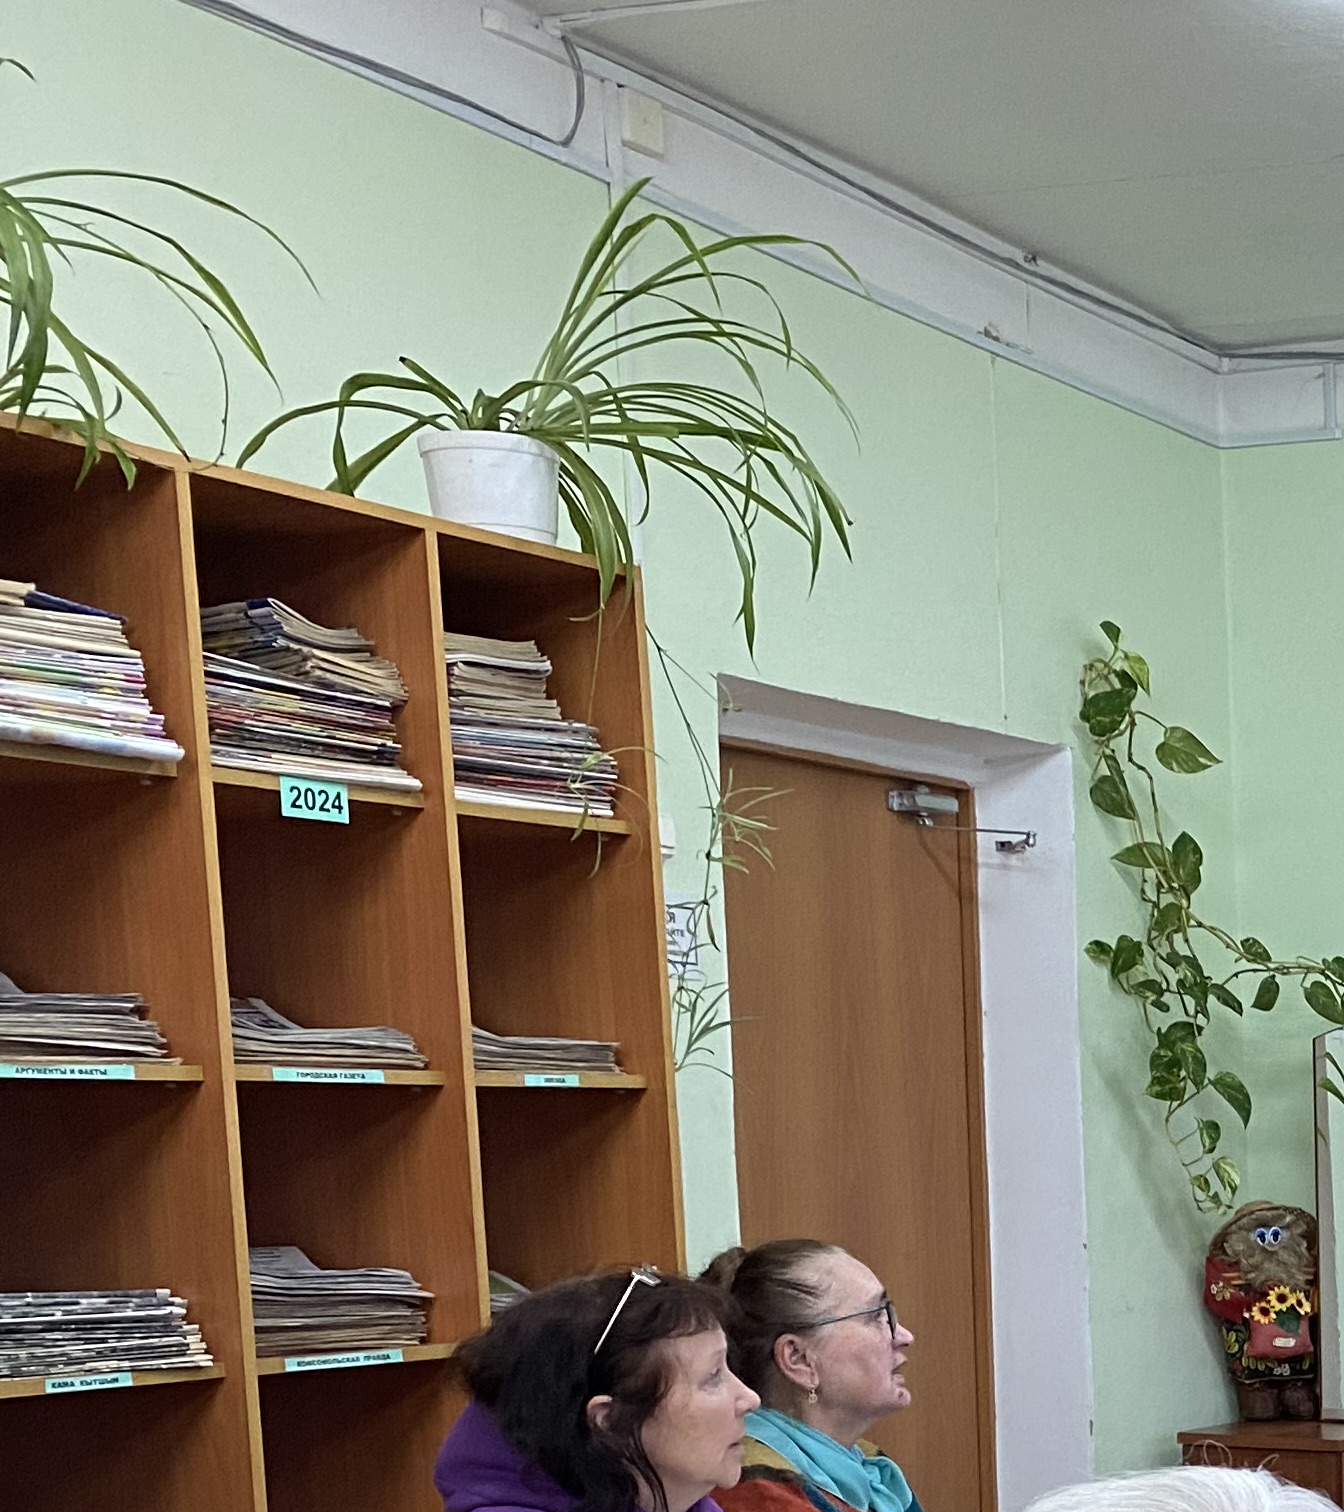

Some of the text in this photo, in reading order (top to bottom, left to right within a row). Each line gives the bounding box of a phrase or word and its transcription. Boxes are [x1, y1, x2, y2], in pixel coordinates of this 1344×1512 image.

[289, 785, 344, 815] 2024
[15, 1067, 67, 1075] АРГУМЕНТЫ
[77, 1068, 107, 1076] ФАКТЫ
[296, 1071, 338, 1079] ГОРОДСКАЯ
[297, 1353, 391, 1367] КОМСОМОЛЬСКАЯ ПРАВДА
